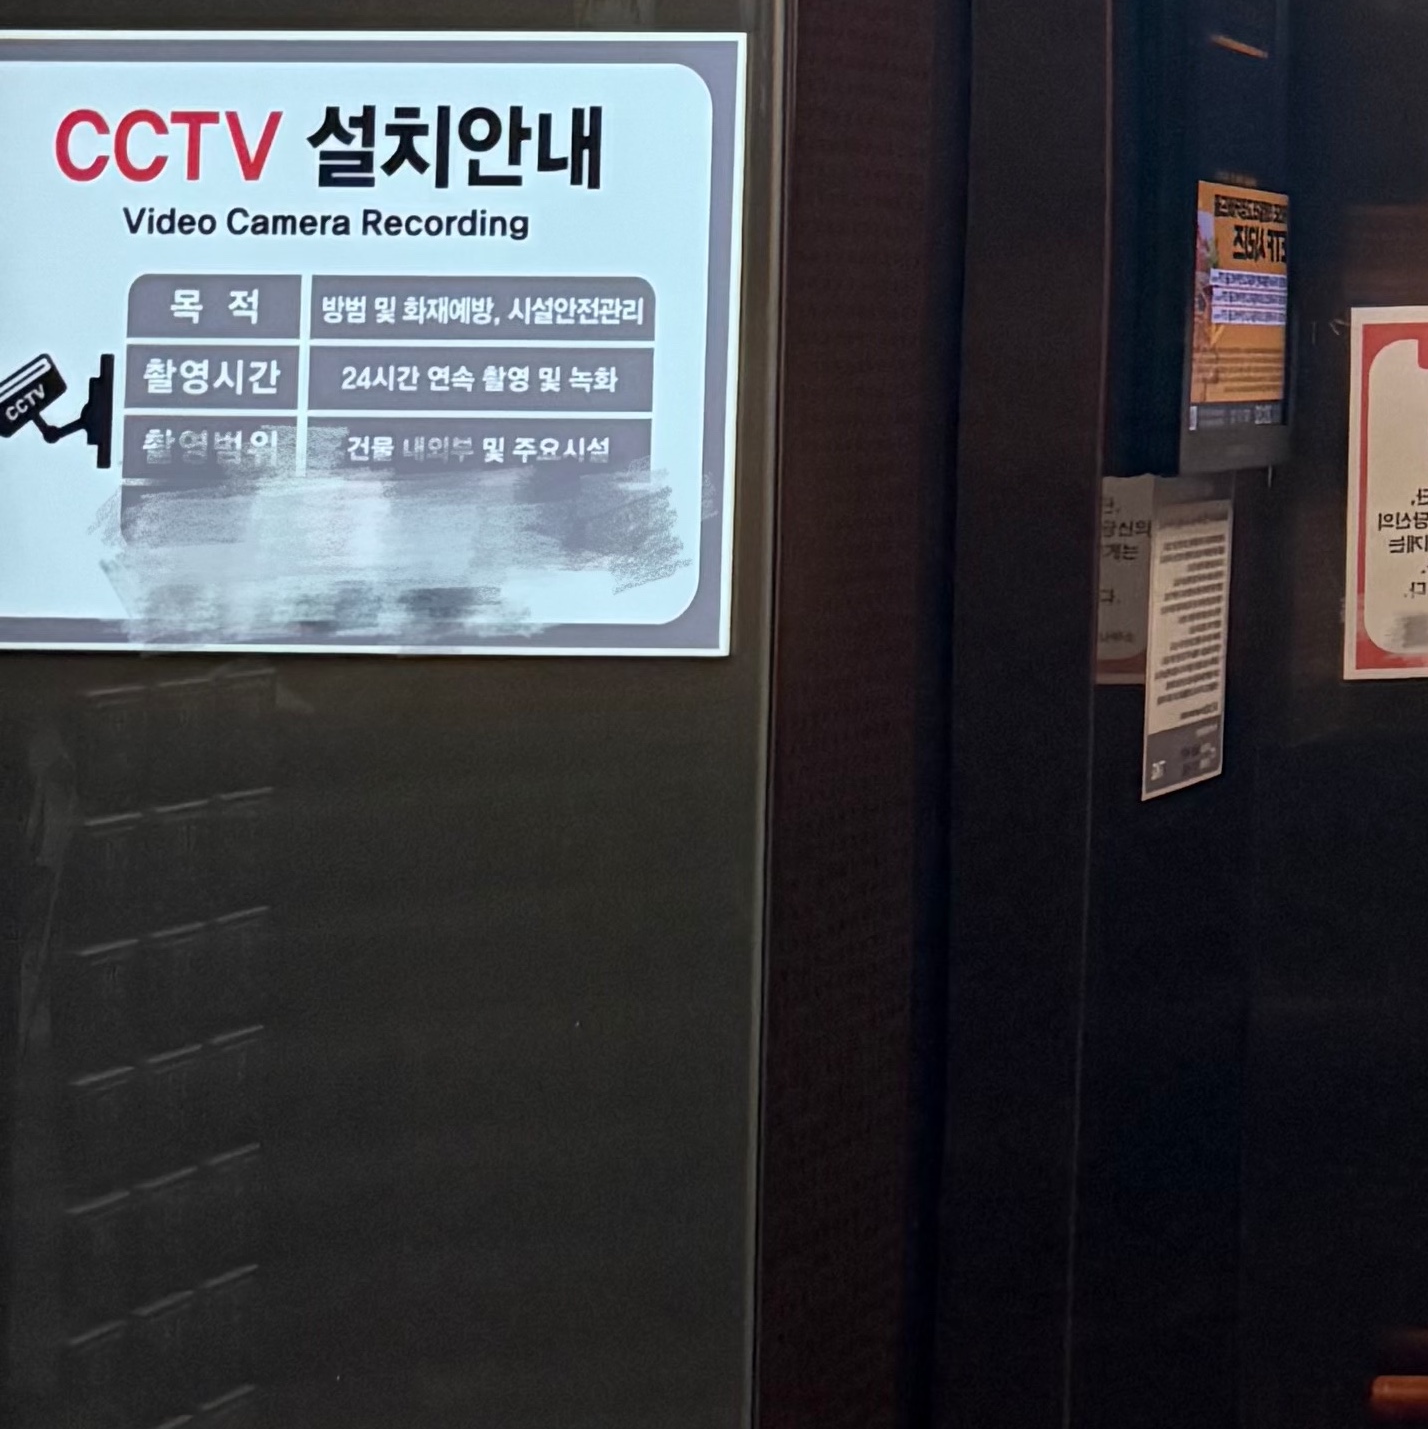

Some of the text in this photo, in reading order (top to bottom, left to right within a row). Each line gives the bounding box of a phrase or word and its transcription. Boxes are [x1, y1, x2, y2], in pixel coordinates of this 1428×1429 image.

[54, 104, 604, 190] CCTV 설치안내
[123, 206, 530, 241] Video Camera Recording
[322, 295, 644, 327] 방범 및 화재예방, 시설안전관리
[143, 357, 281, 396] 촬영시간
[341, 364, 619, 394] 24시간 연속 촬영 및 녹화
[5, 383, 46, 421] CCTV
[347, 435, 395, 463] 건물
[482, 436, 506, 463] 및
[512, 436, 611, 464] 주요시설
